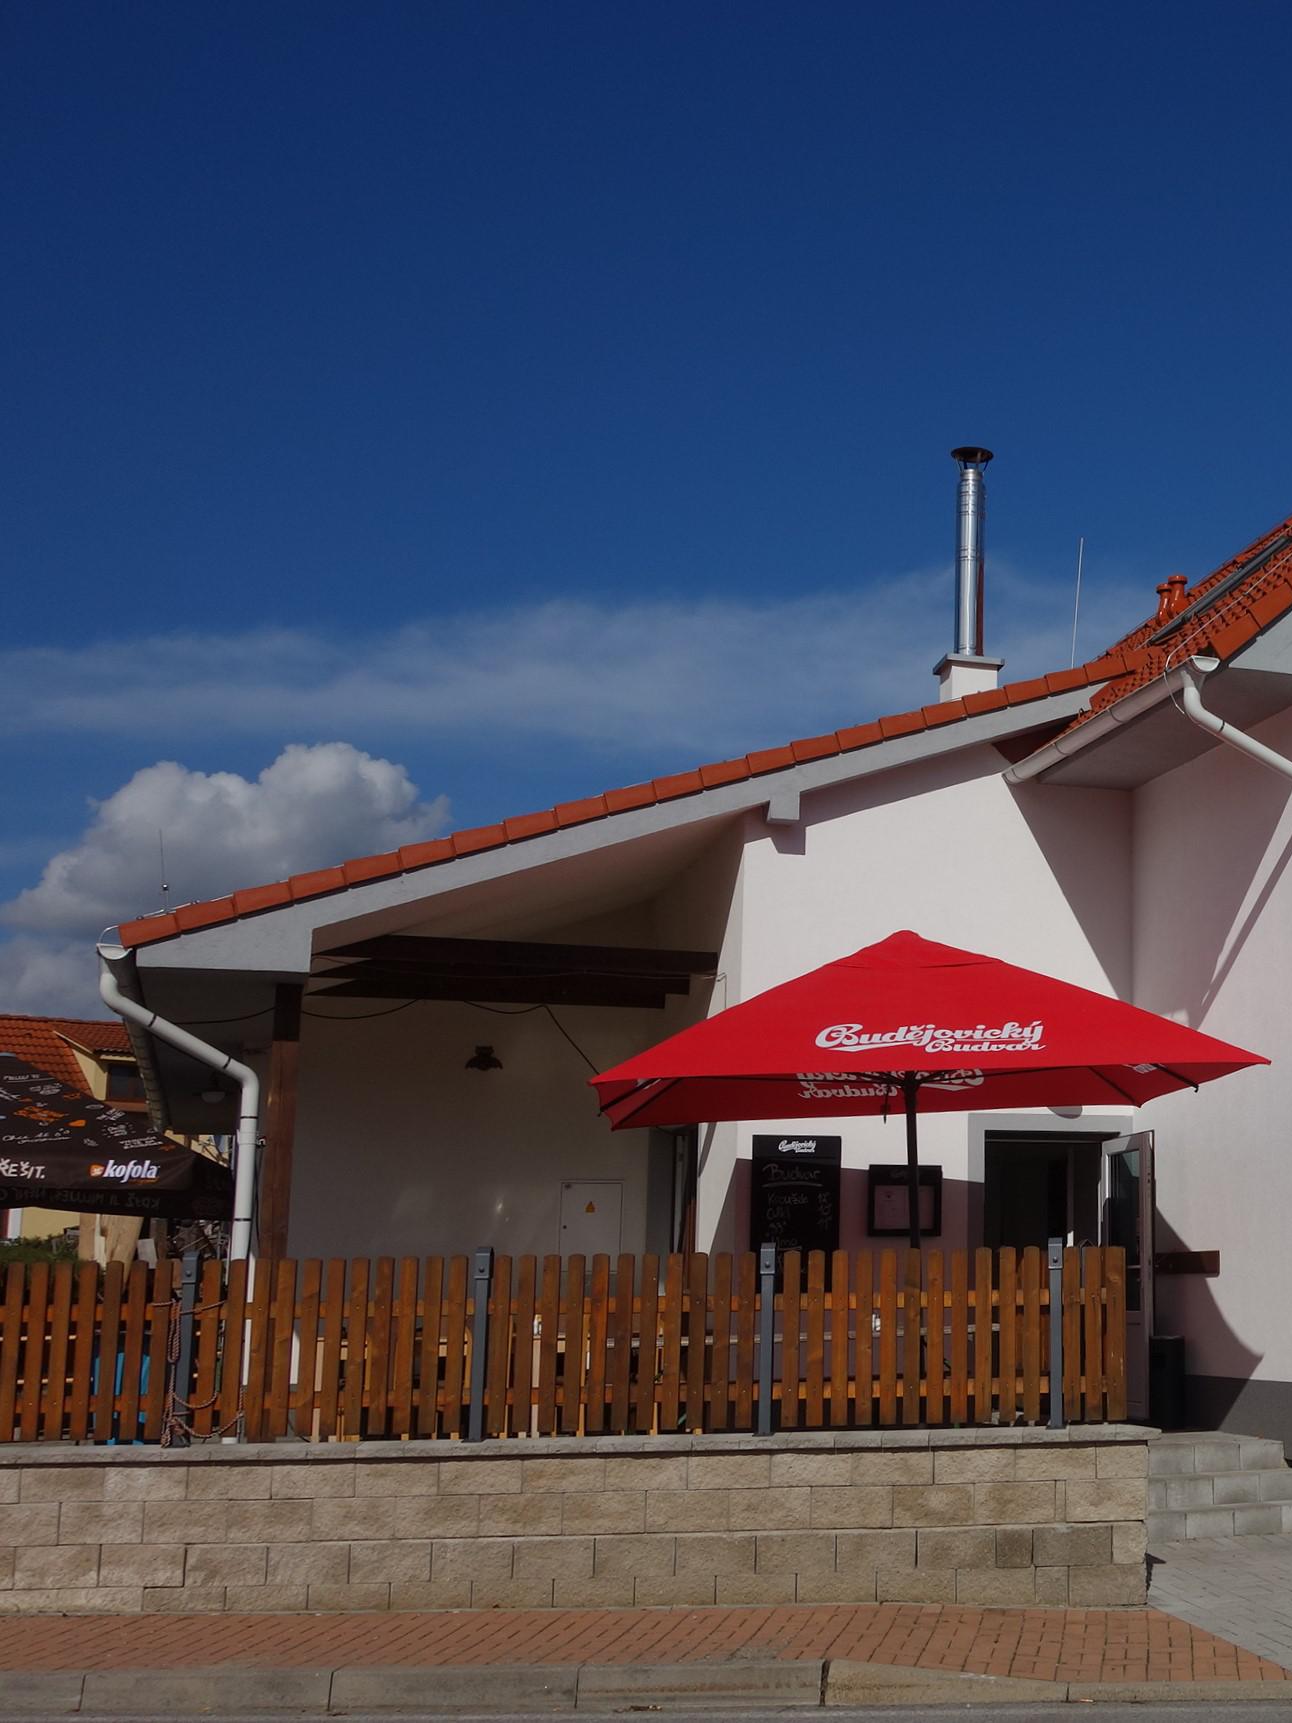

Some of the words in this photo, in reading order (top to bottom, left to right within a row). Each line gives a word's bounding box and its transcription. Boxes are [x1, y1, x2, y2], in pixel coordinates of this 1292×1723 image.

[815, 1020, 1043, 1051] Budějovický
[103, 1160, 159, 1183] kofola
[762, 1163, 822, 1181] Budvar
